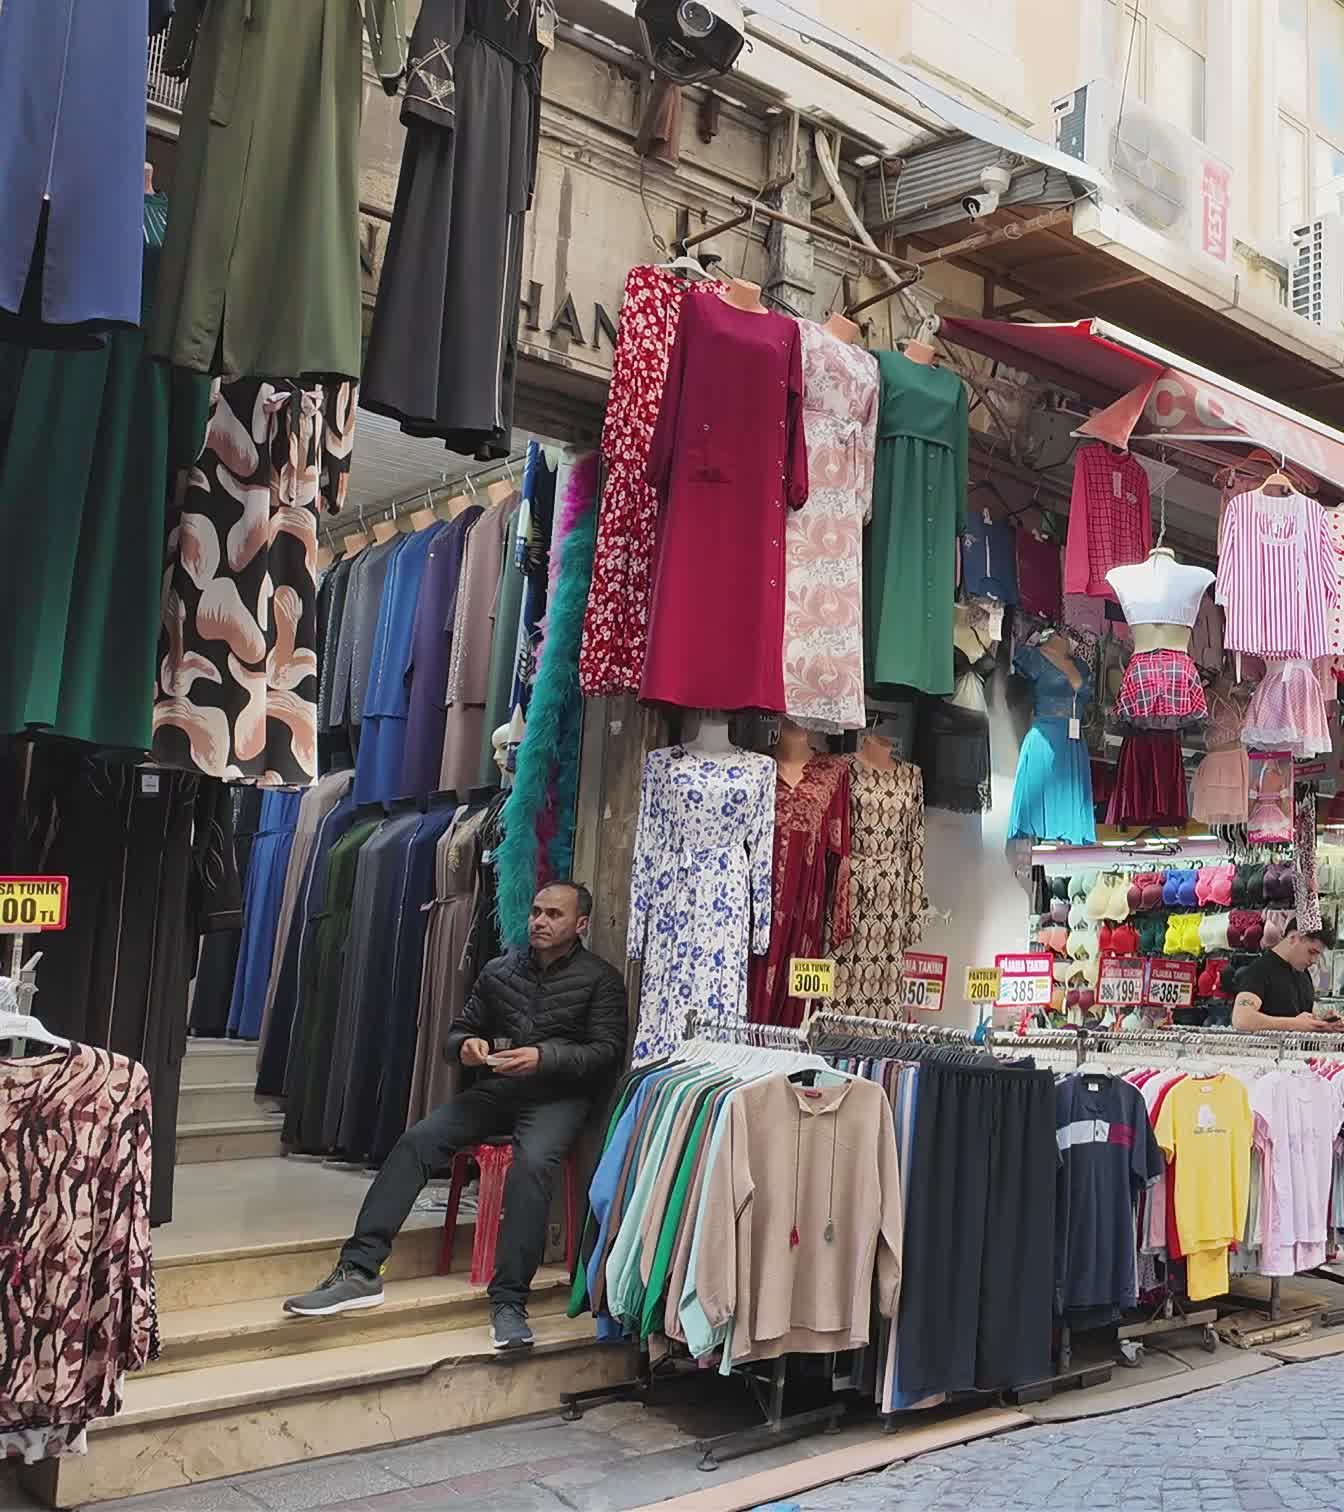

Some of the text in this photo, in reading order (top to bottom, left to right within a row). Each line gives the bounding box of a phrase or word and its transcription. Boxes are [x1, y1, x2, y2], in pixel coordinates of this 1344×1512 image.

[19, 882, 60, 895] TUNİK
[40, 910, 55, 922] TL
[811, 962, 831, 973] TUNİK
[795, 974, 820, 993] 300
[971, 983, 990, 998] 200
[1011, 980, 1034, 1002] 385
[1160, 982, 1179, 1003] 385
